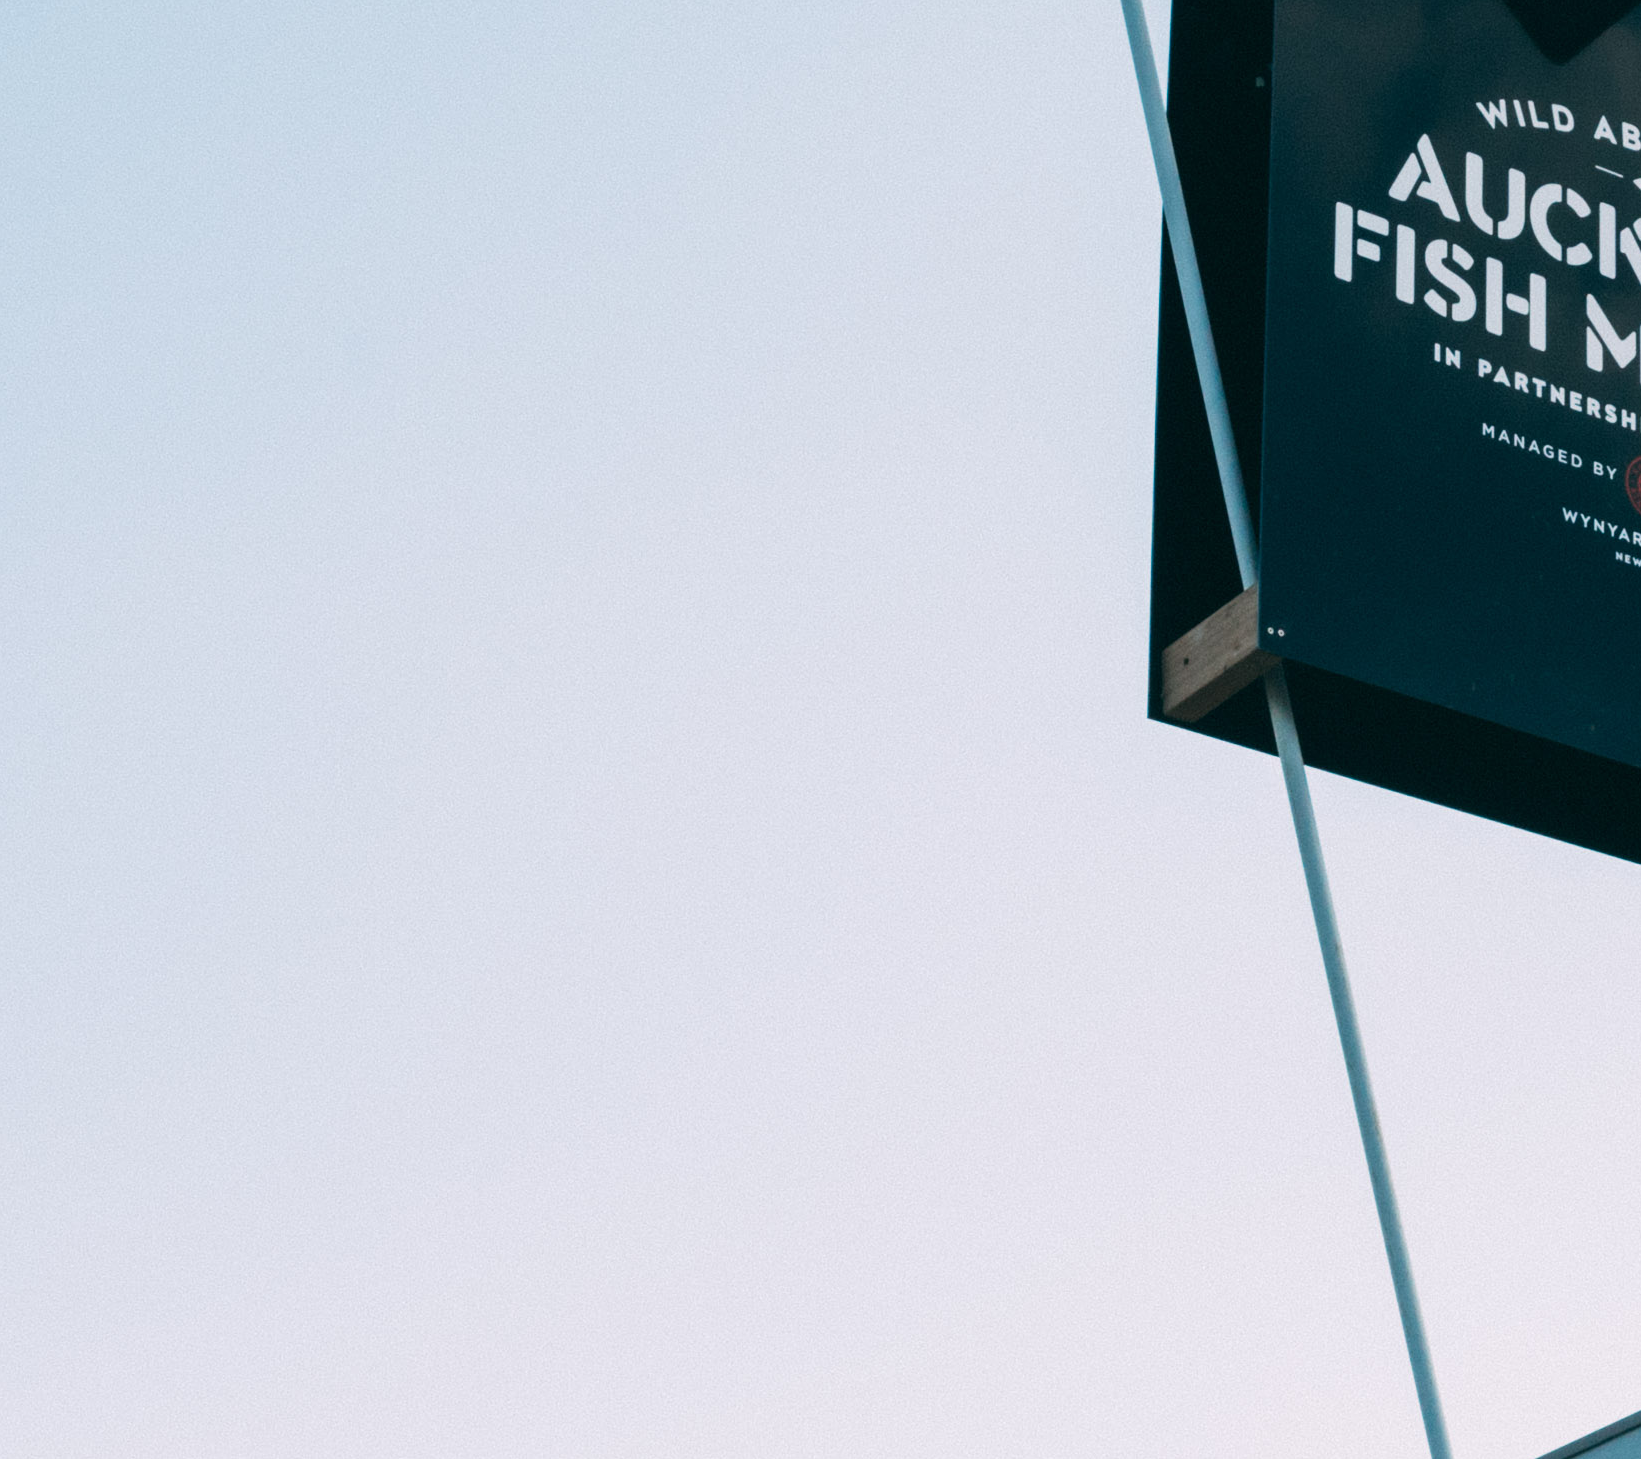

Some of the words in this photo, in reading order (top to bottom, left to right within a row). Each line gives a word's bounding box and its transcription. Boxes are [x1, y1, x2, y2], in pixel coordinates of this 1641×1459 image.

[1475, 98, 1575, 133] WILD
[1333, 201, 1547, 352] FISH
[1433, 342, 1461, 369] IN
[1482, 422, 1583, 468] MANAGED
[1593, 461, 1618, 481] BY
